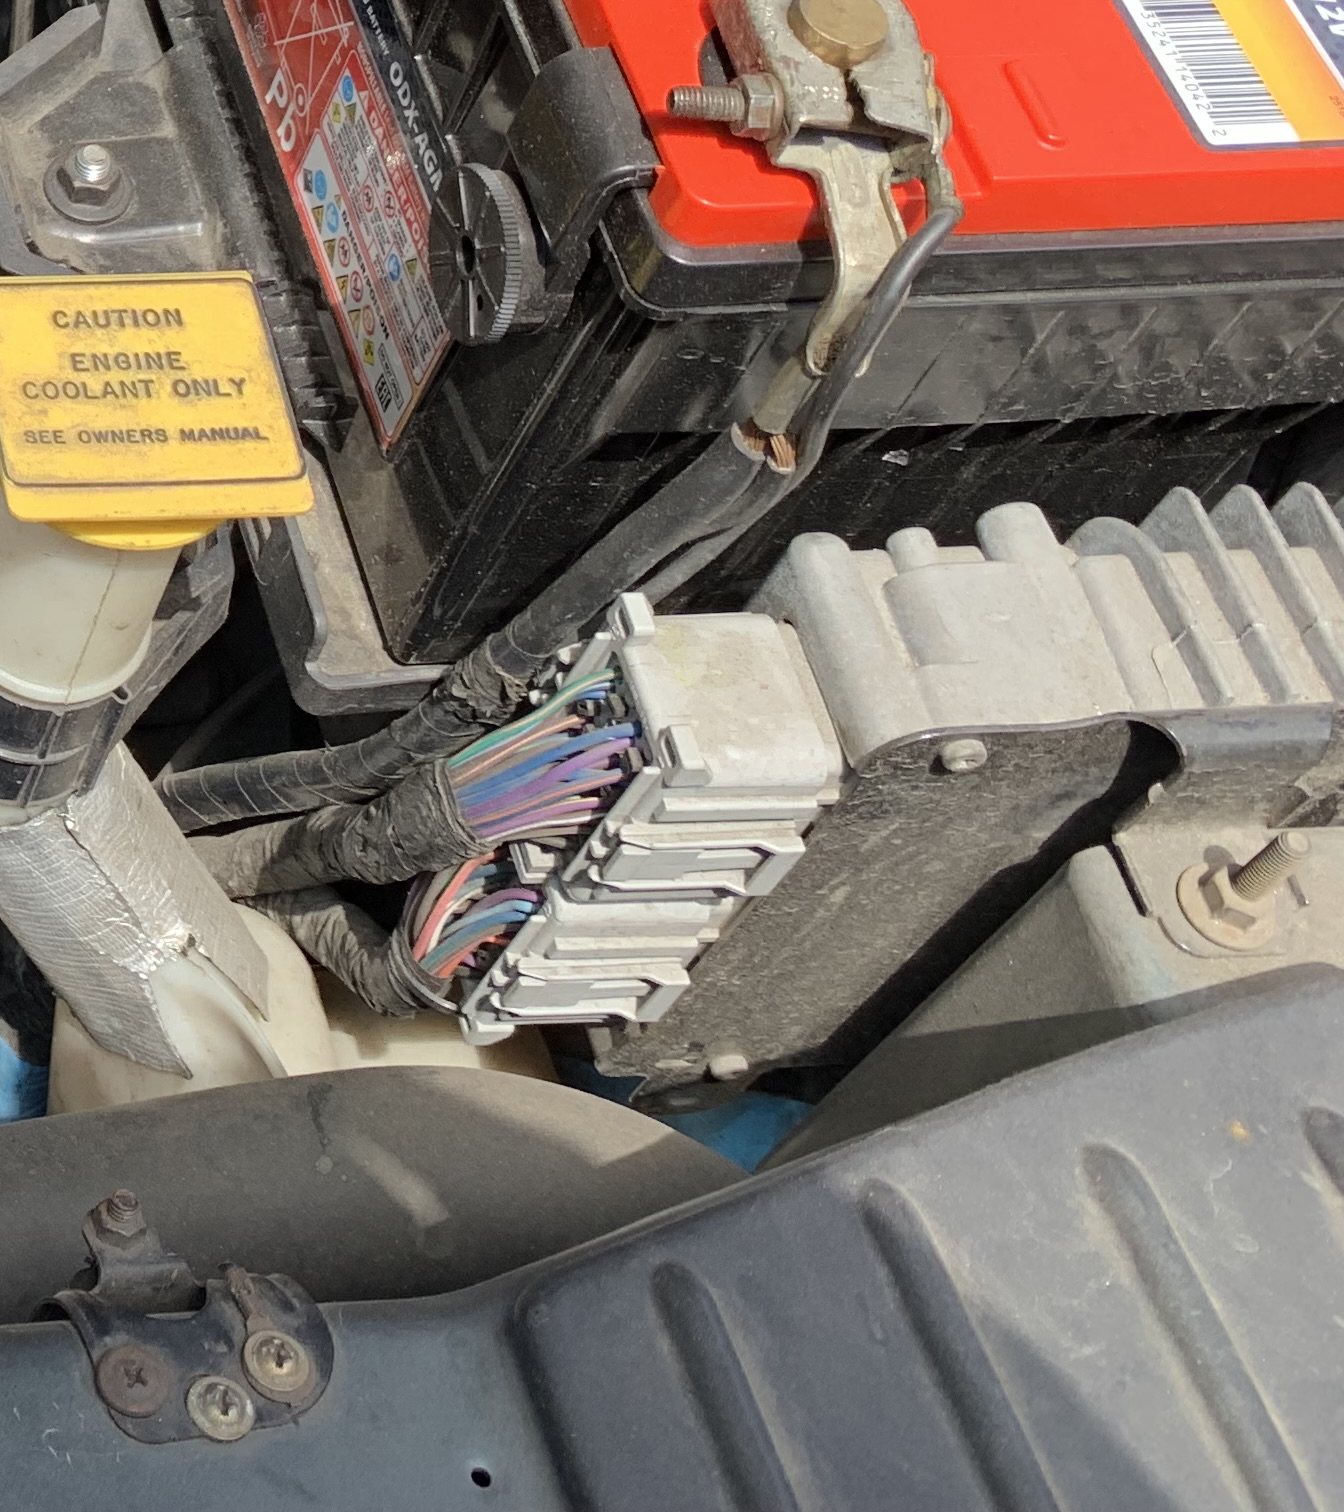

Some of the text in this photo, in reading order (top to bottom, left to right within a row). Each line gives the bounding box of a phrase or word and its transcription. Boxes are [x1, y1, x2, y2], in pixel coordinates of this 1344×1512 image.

[367, 3, 391, 56] BATTERY
[1141, 12, 1178, 57] 35241
[1176, 66, 1211, 111] 14042
[1212, 129, 1227, 137] 2
[265, 68, 297, 152] Pb
[52, 307, 184, 330] CAUTION
[70, 351, 187, 372] ENGINE
[22, 377, 247, 401] COOLANT ONLY
[23, 426, 270, 445] SEE OWNERS MANUAL
